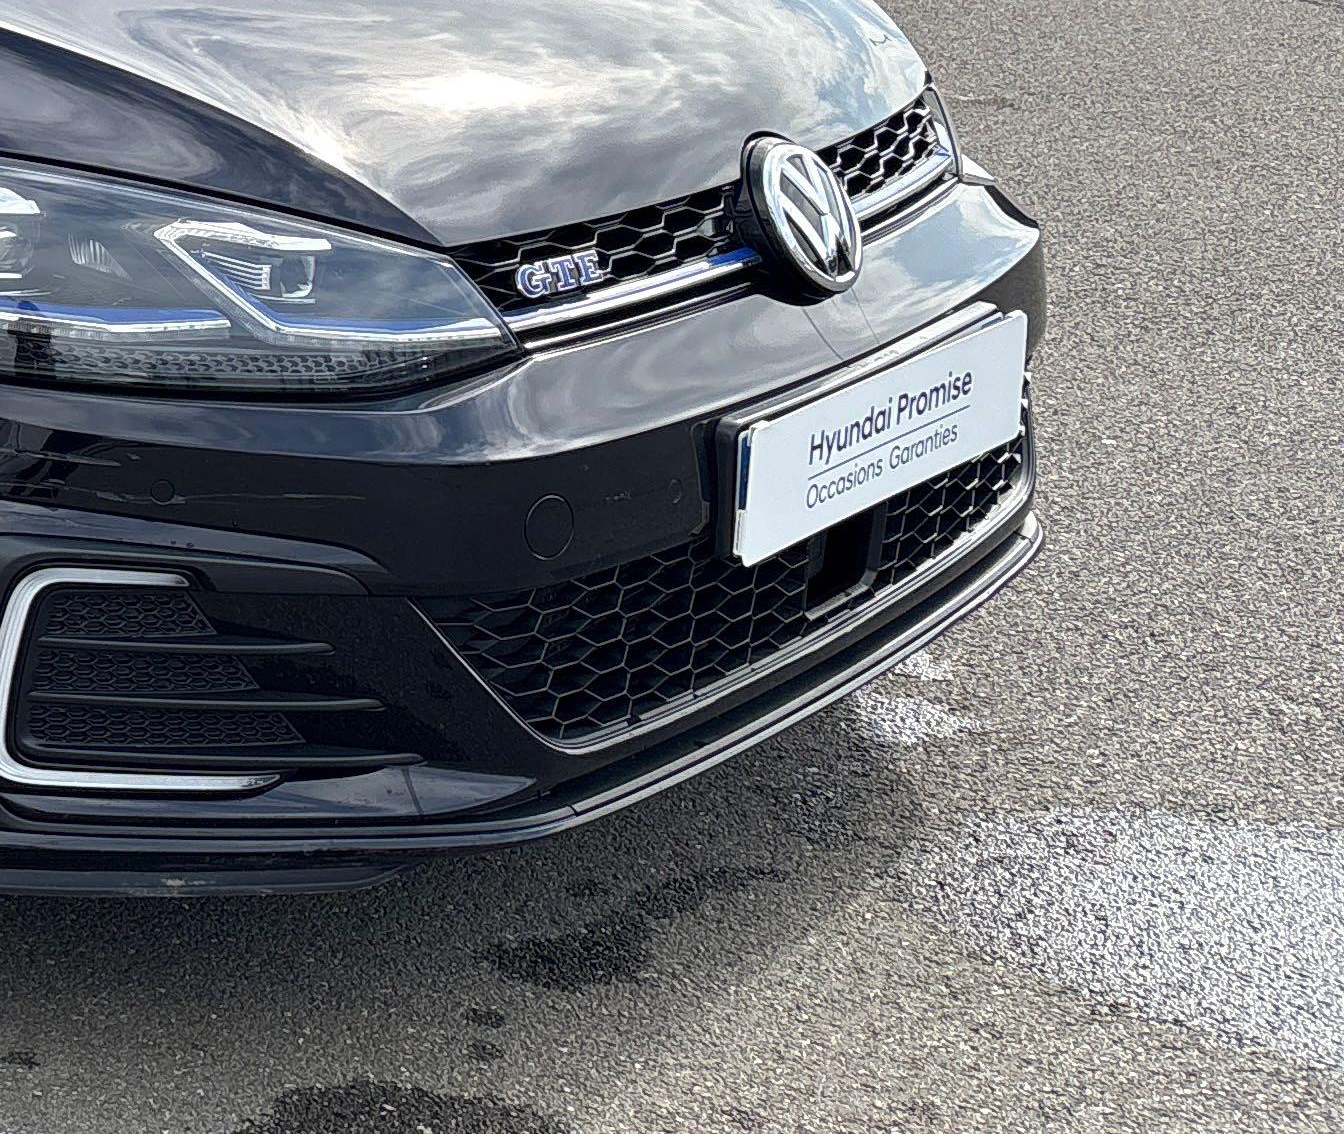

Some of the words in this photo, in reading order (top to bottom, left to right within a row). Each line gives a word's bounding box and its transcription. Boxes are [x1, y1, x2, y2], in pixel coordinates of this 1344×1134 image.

[515, 249, 605, 298] GTE
[808, 407, 893, 466] Hyundai
[895, 370, 973, 423] Promise
[806, 461, 883, 509] Occasions
[888, 422, 959, 468] Garanties
